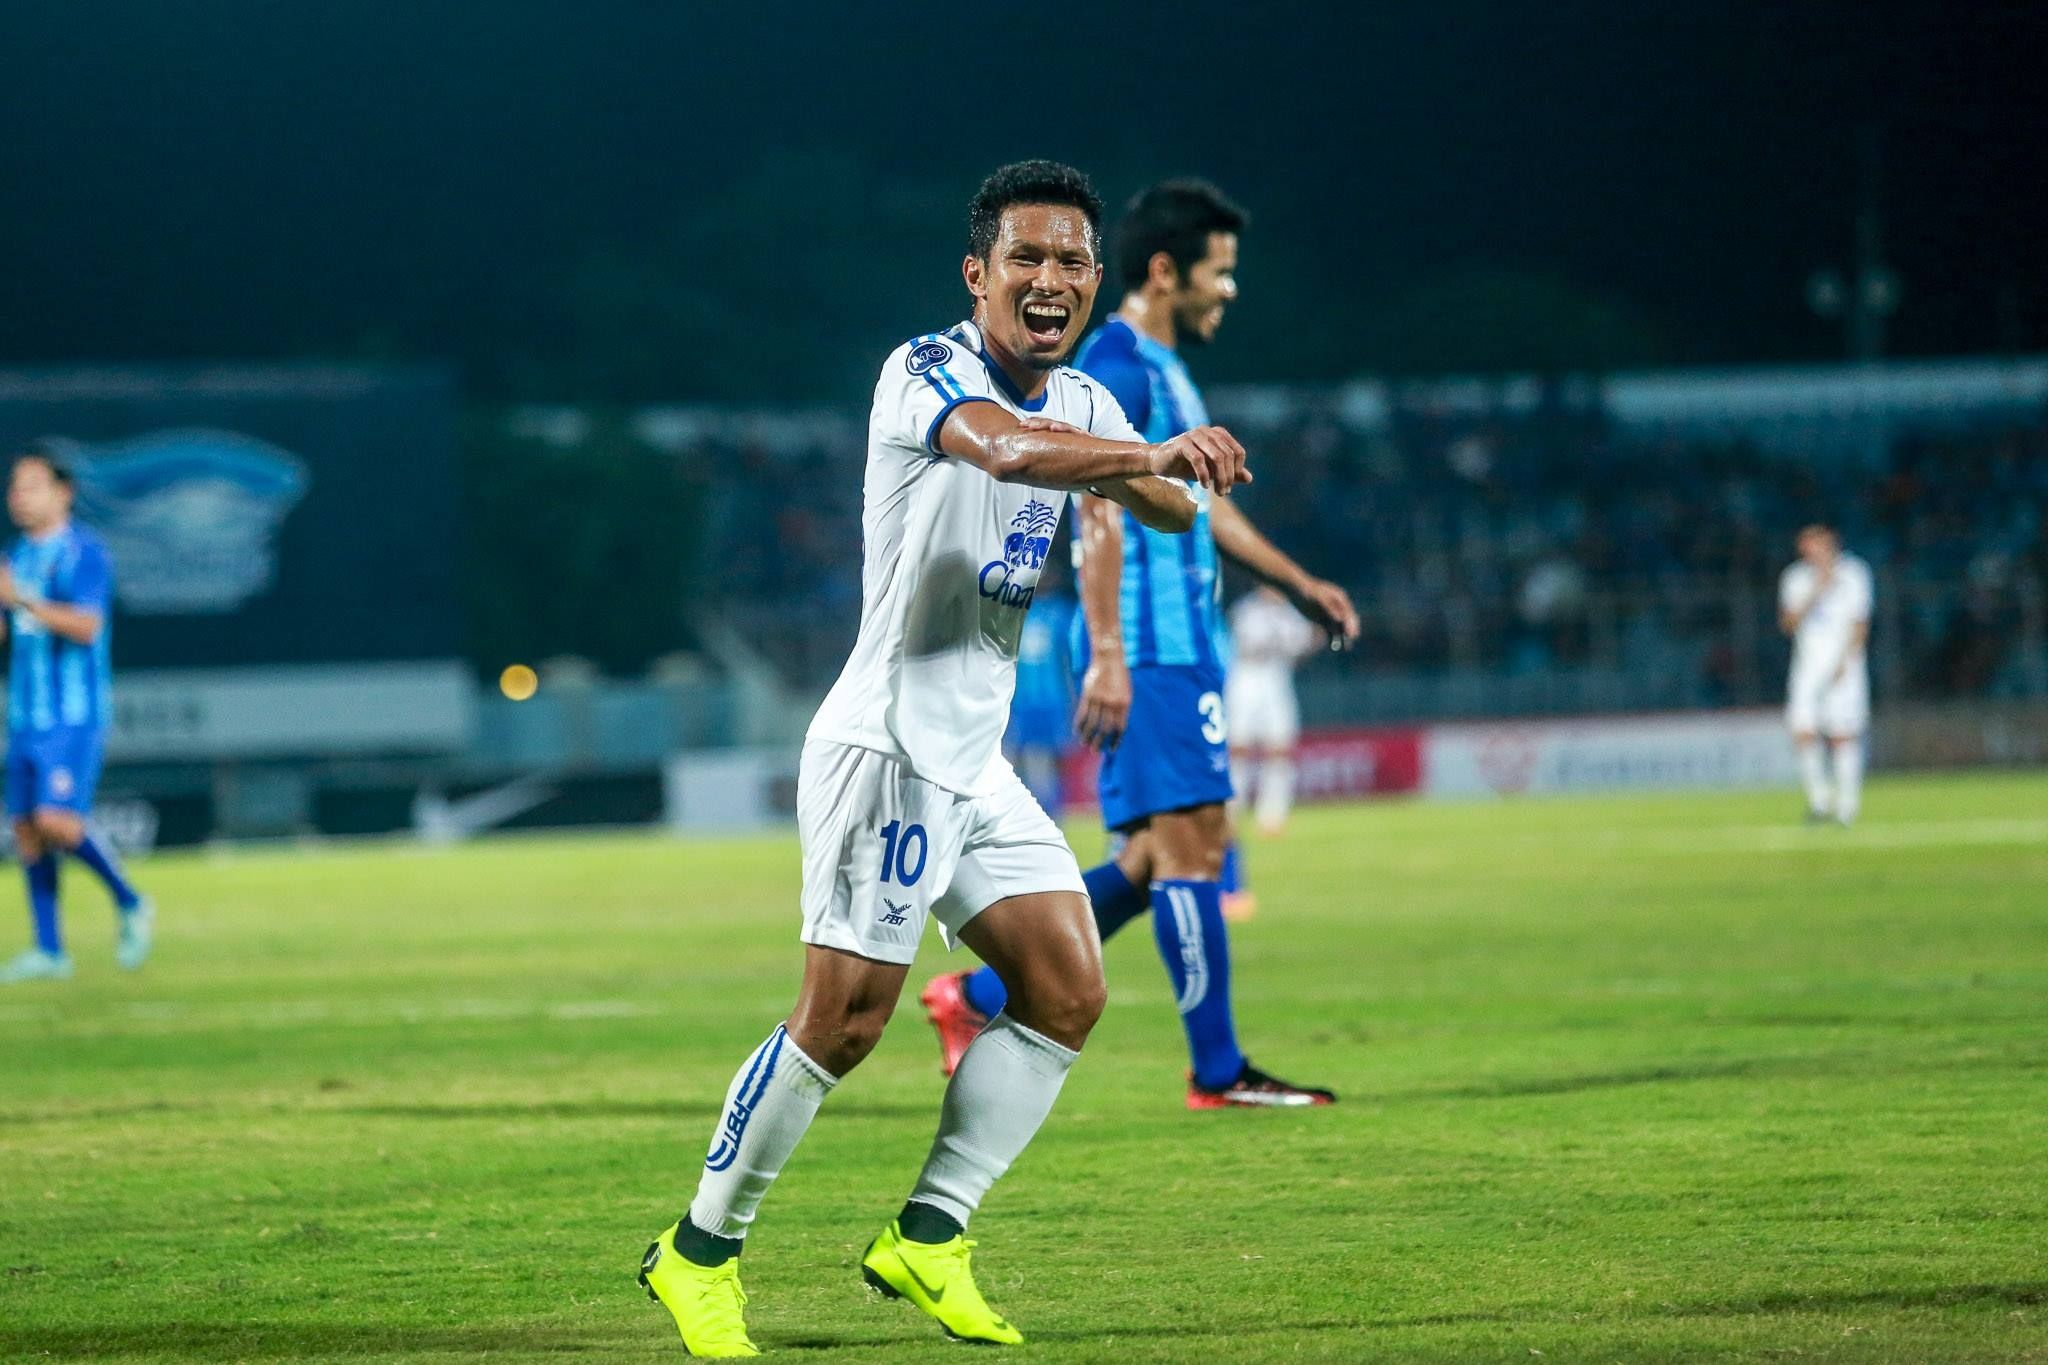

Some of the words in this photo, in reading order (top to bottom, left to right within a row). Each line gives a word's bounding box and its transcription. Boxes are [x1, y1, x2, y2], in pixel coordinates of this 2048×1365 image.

[1198, 691, 1227, 745] 3
[879, 819, 928, 888] 10
[878, 913, 908, 926] FBT
[724, 1099, 751, 1151] FBT
